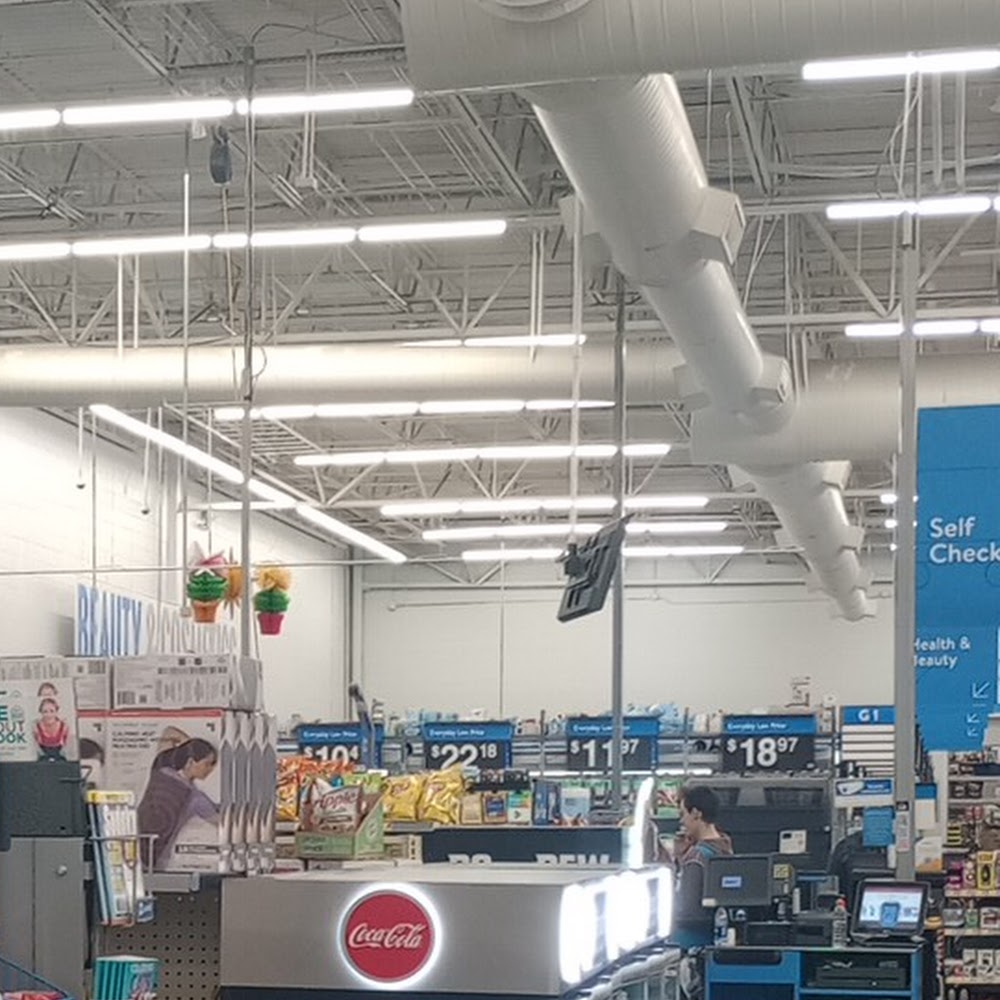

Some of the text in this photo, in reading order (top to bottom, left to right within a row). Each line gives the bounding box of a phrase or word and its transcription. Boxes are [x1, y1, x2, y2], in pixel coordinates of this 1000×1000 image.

[930, 517, 975, 538] Self
[929, 543, 1000, 564] Check
[78, 585, 142, 656] BEAUTY
[960, 636, 971, 650] &
[858, 709, 880, 722] G1
[429, 729, 456, 739] Everyday
[727, 722, 756, 731] Everyday
[348, 922, 428, 949] Coca-Cola
